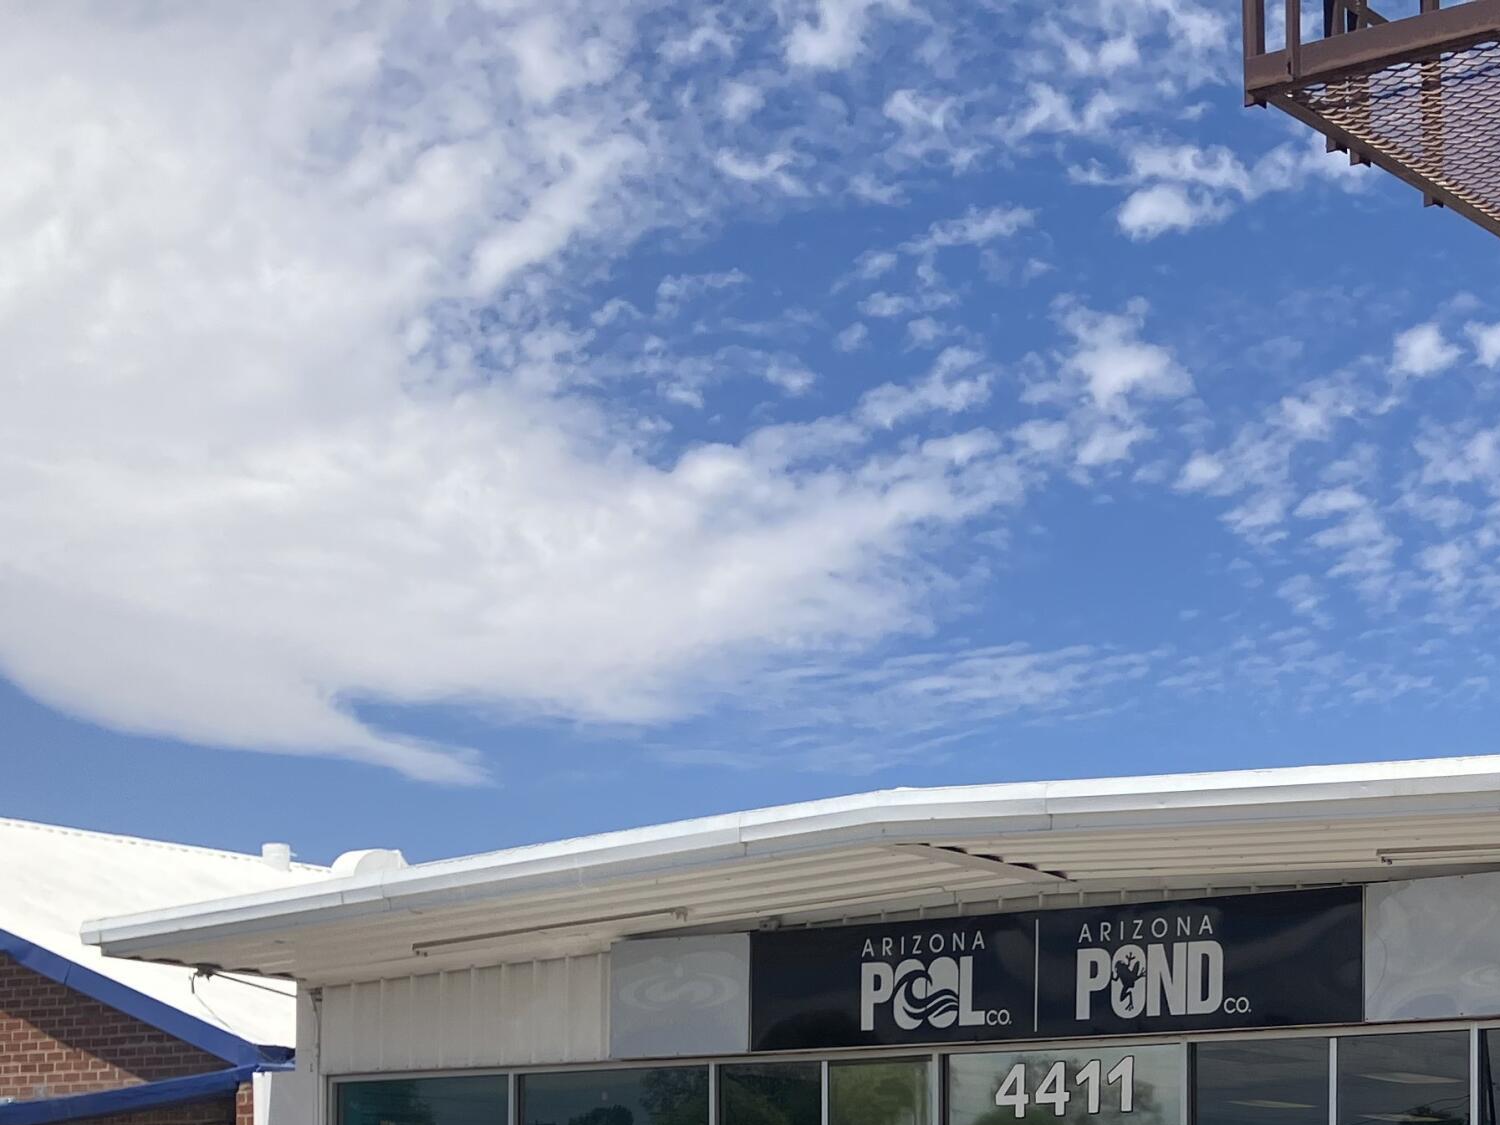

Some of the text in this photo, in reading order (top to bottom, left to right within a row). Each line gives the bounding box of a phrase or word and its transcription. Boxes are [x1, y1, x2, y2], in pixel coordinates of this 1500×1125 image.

[861, 930, 985, 957] ARIZONA
[1078, 914, 1214, 943] ARIZONA
[860, 955, 986, 1032] POOL
[1075, 940, 1224, 1021] POND
[994, 1055, 1135, 1119] 4411
